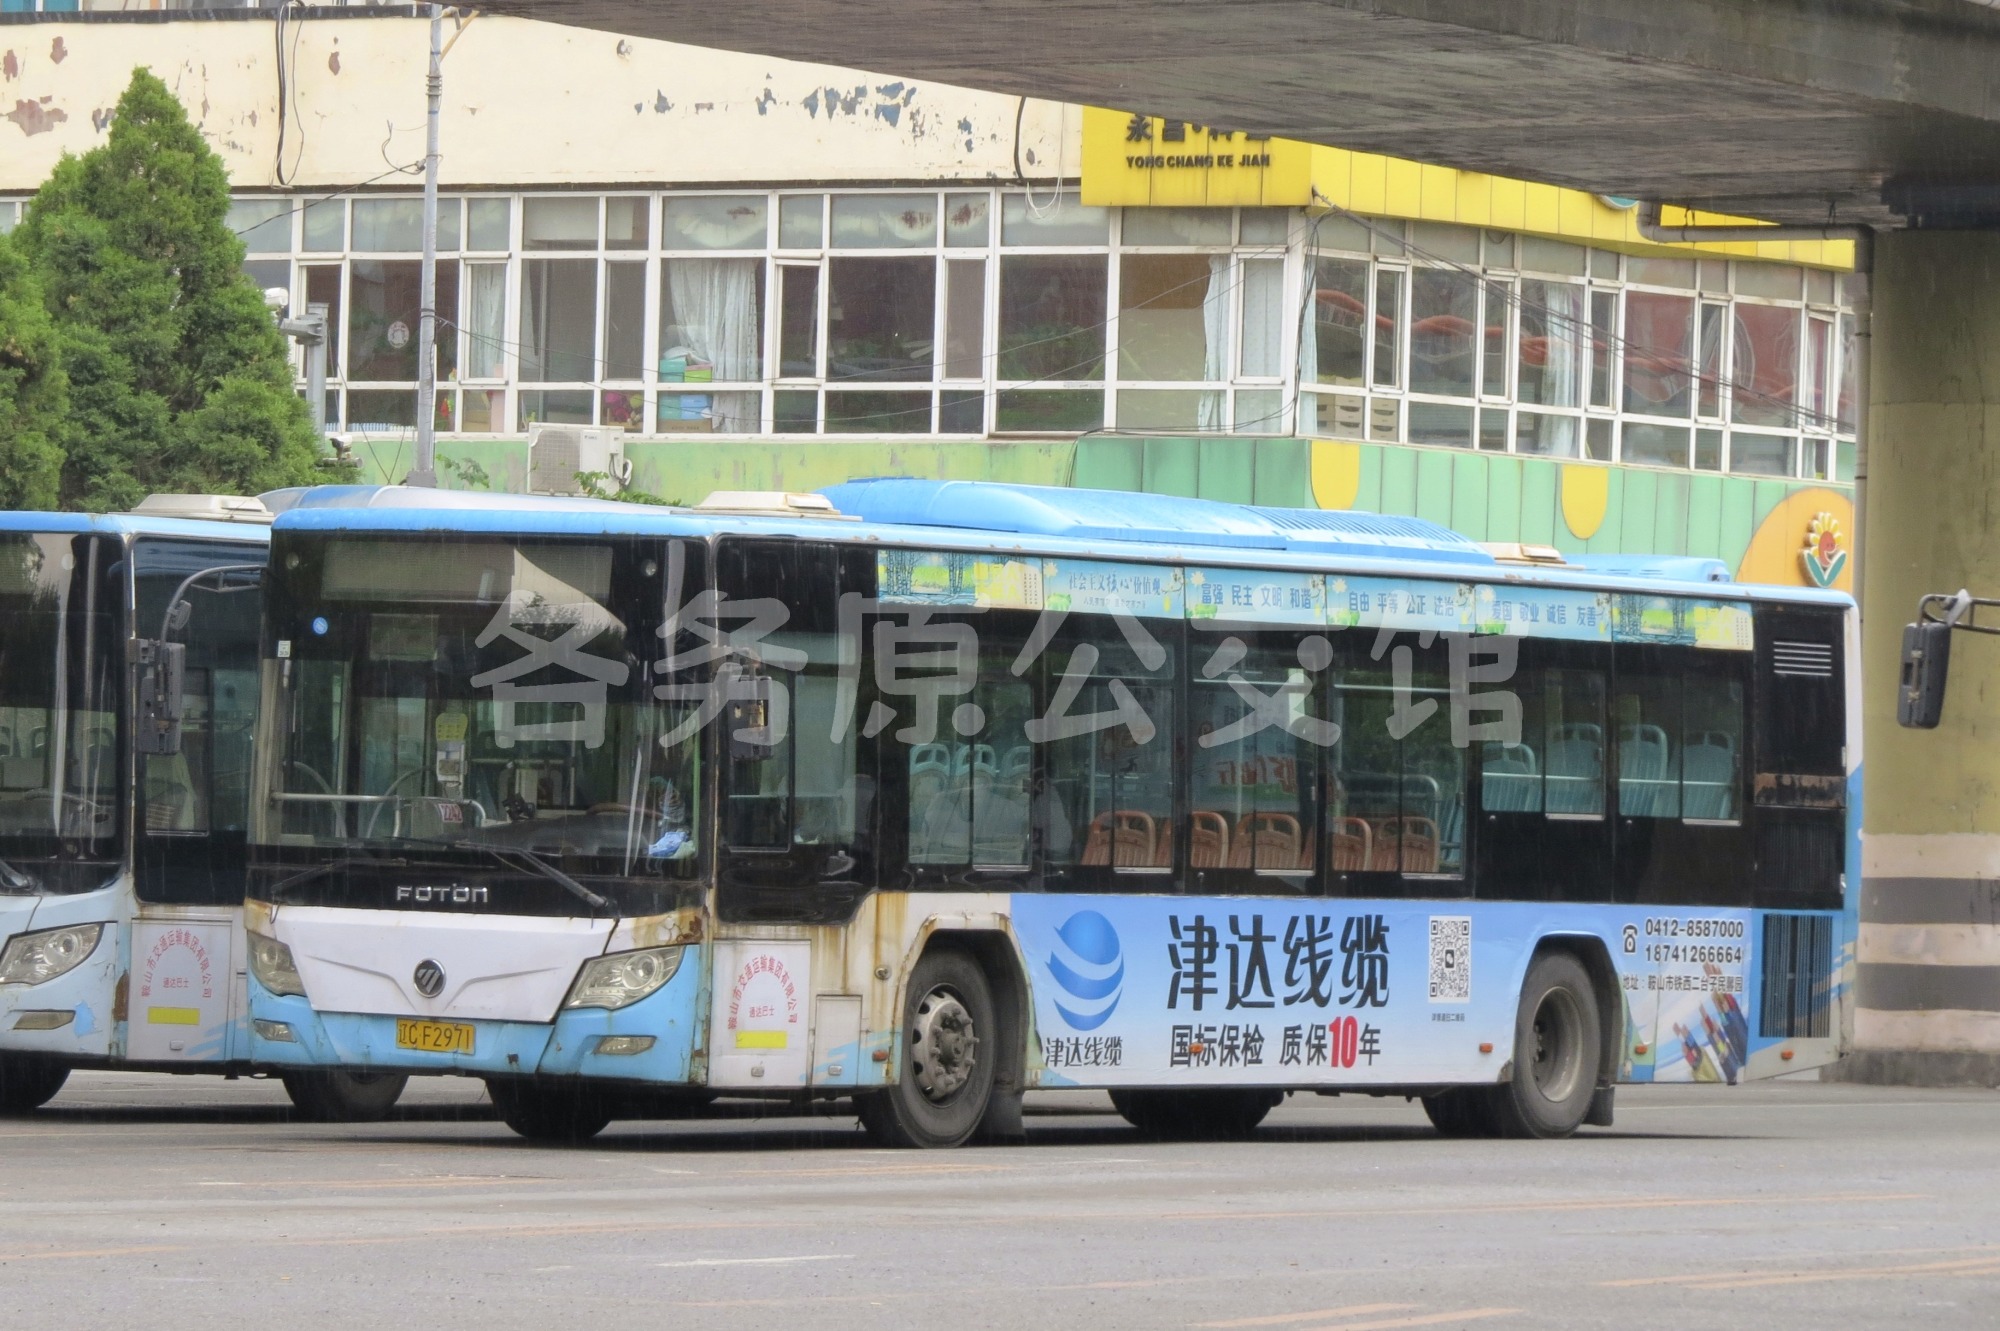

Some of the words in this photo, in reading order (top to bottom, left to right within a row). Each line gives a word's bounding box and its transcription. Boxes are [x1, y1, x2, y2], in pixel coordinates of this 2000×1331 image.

[1126, 156, 1164, 168] YONG
[1166, 156, 1213, 168] CHANG
[1217, 155, 1233, 167] KE
[1239, 154, 1270, 167] JIAN
[1069, 572, 1161, 596] 社会主义核心价值观
[1201, 583, 1224, 605] 富强
[1231, 585, 1253, 606] 民主
[1261, 586, 1282, 607] 文明
[1290, 588, 1311, 609] 和谐
[1349, 591, 1370, 612] 自由
[1377, 592, 1398, 614] 平等
[1407, 594, 1426, 615] 公正
[1434, 596, 1454, 617] 法治
[1492, 600, 1513, 621] 爱国
[1519, 602, 1540, 622] 敬业
[1546, 604, 1566, 624] 诚信
[1577, 606, 1596, 627] 友善
[396, 883, 488, 903] FOTON
[1645, 919, 1744, 938] 0412-8587000
[1167, 914, 1390, 1011] 津达线缆
[1645, 944, 1742, 963] 18741266664
[163, 977, 189, 988] 通达巴士
[749, 1005, 775, 1018] 通达巴士
[1045, 1036, 1123, 1068] 津达线缆
[1170, 1024, 1265, 1067] 国标保检
[1279, 1016, 1381, 1068] 质保10年
